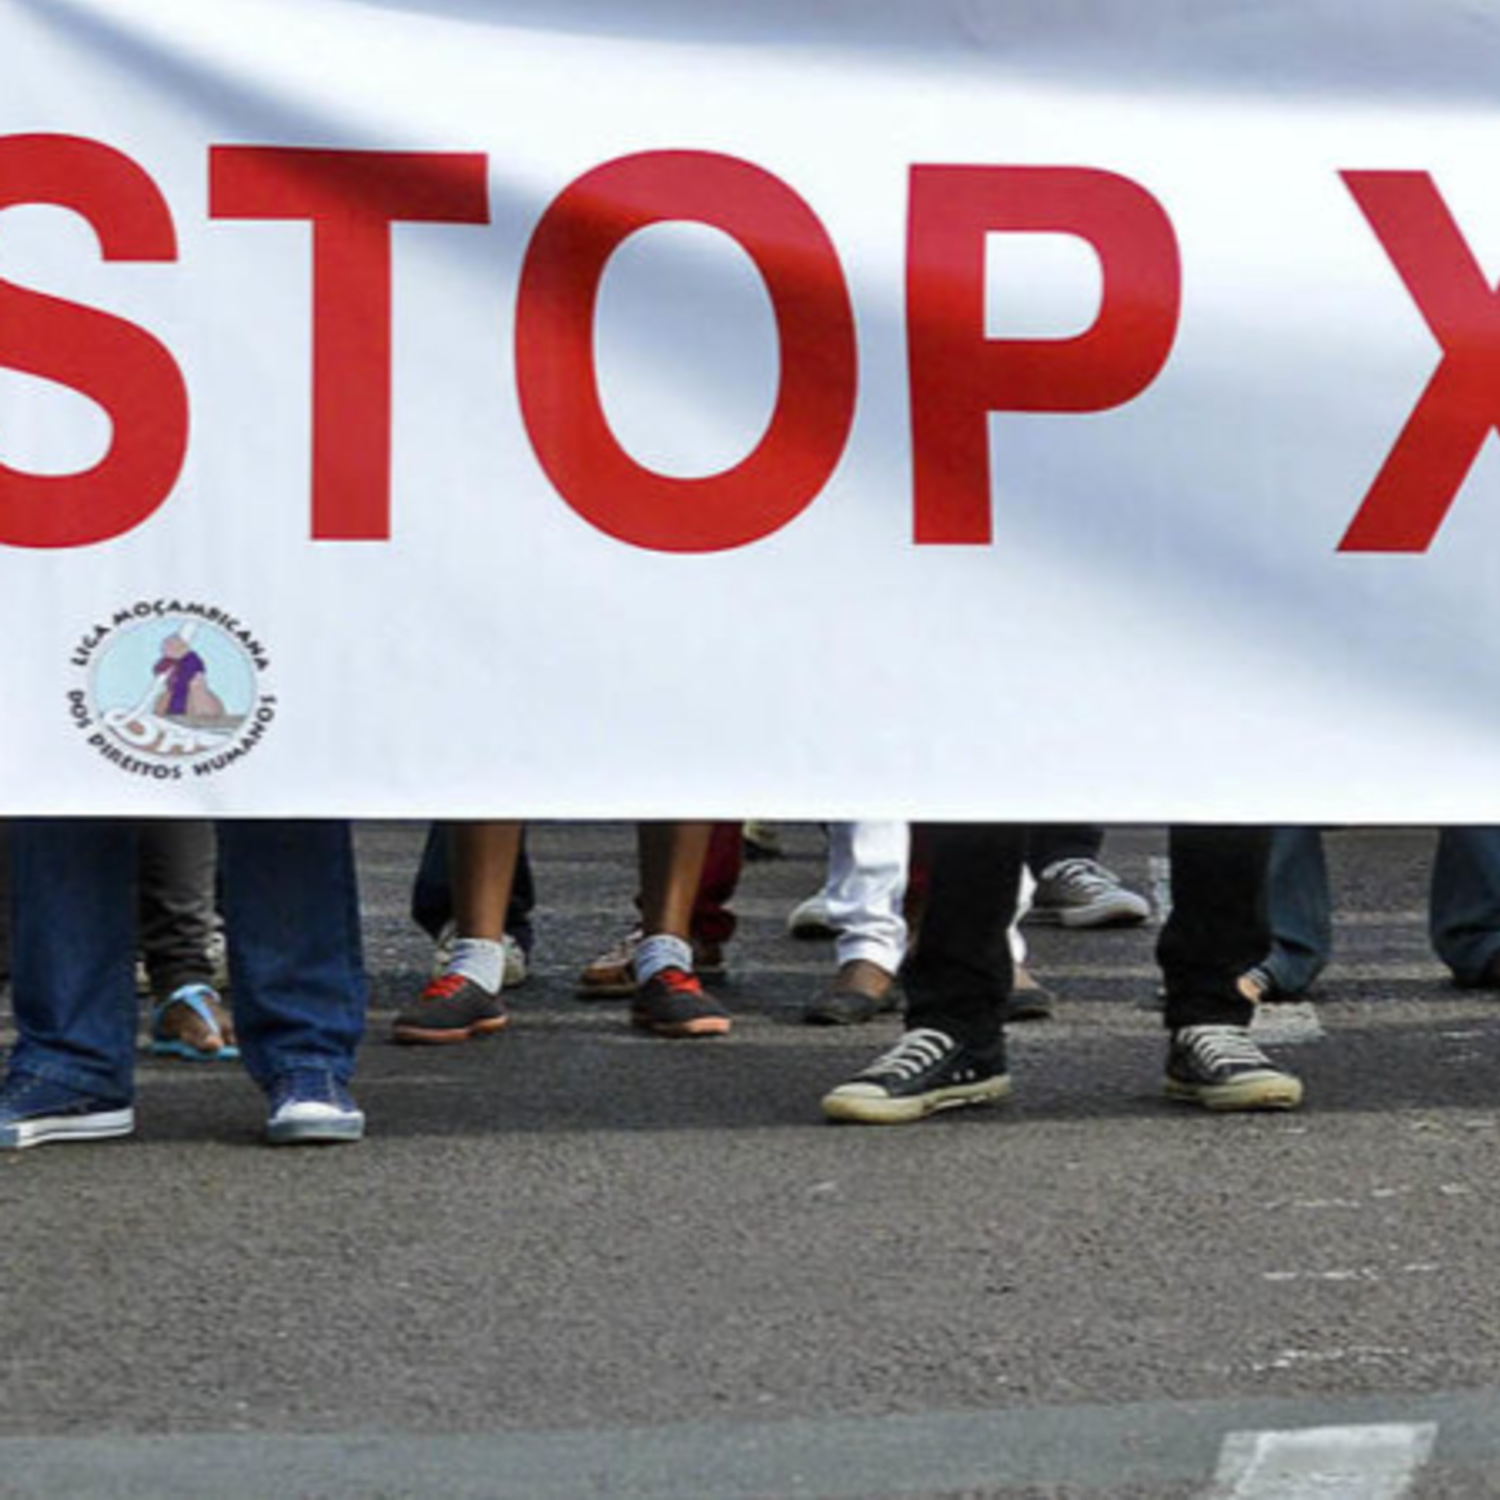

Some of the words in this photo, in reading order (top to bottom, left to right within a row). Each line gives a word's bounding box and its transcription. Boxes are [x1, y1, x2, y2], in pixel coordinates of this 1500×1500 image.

[0, 132, 1182, 555] STOP
[71, 625, 111, 666] LIGA
[113, 599, 269, 670] MOÇAMBICANA
[67, 689, 92, 730] DOS
[87, 733, 182, 780] DIREITOS
